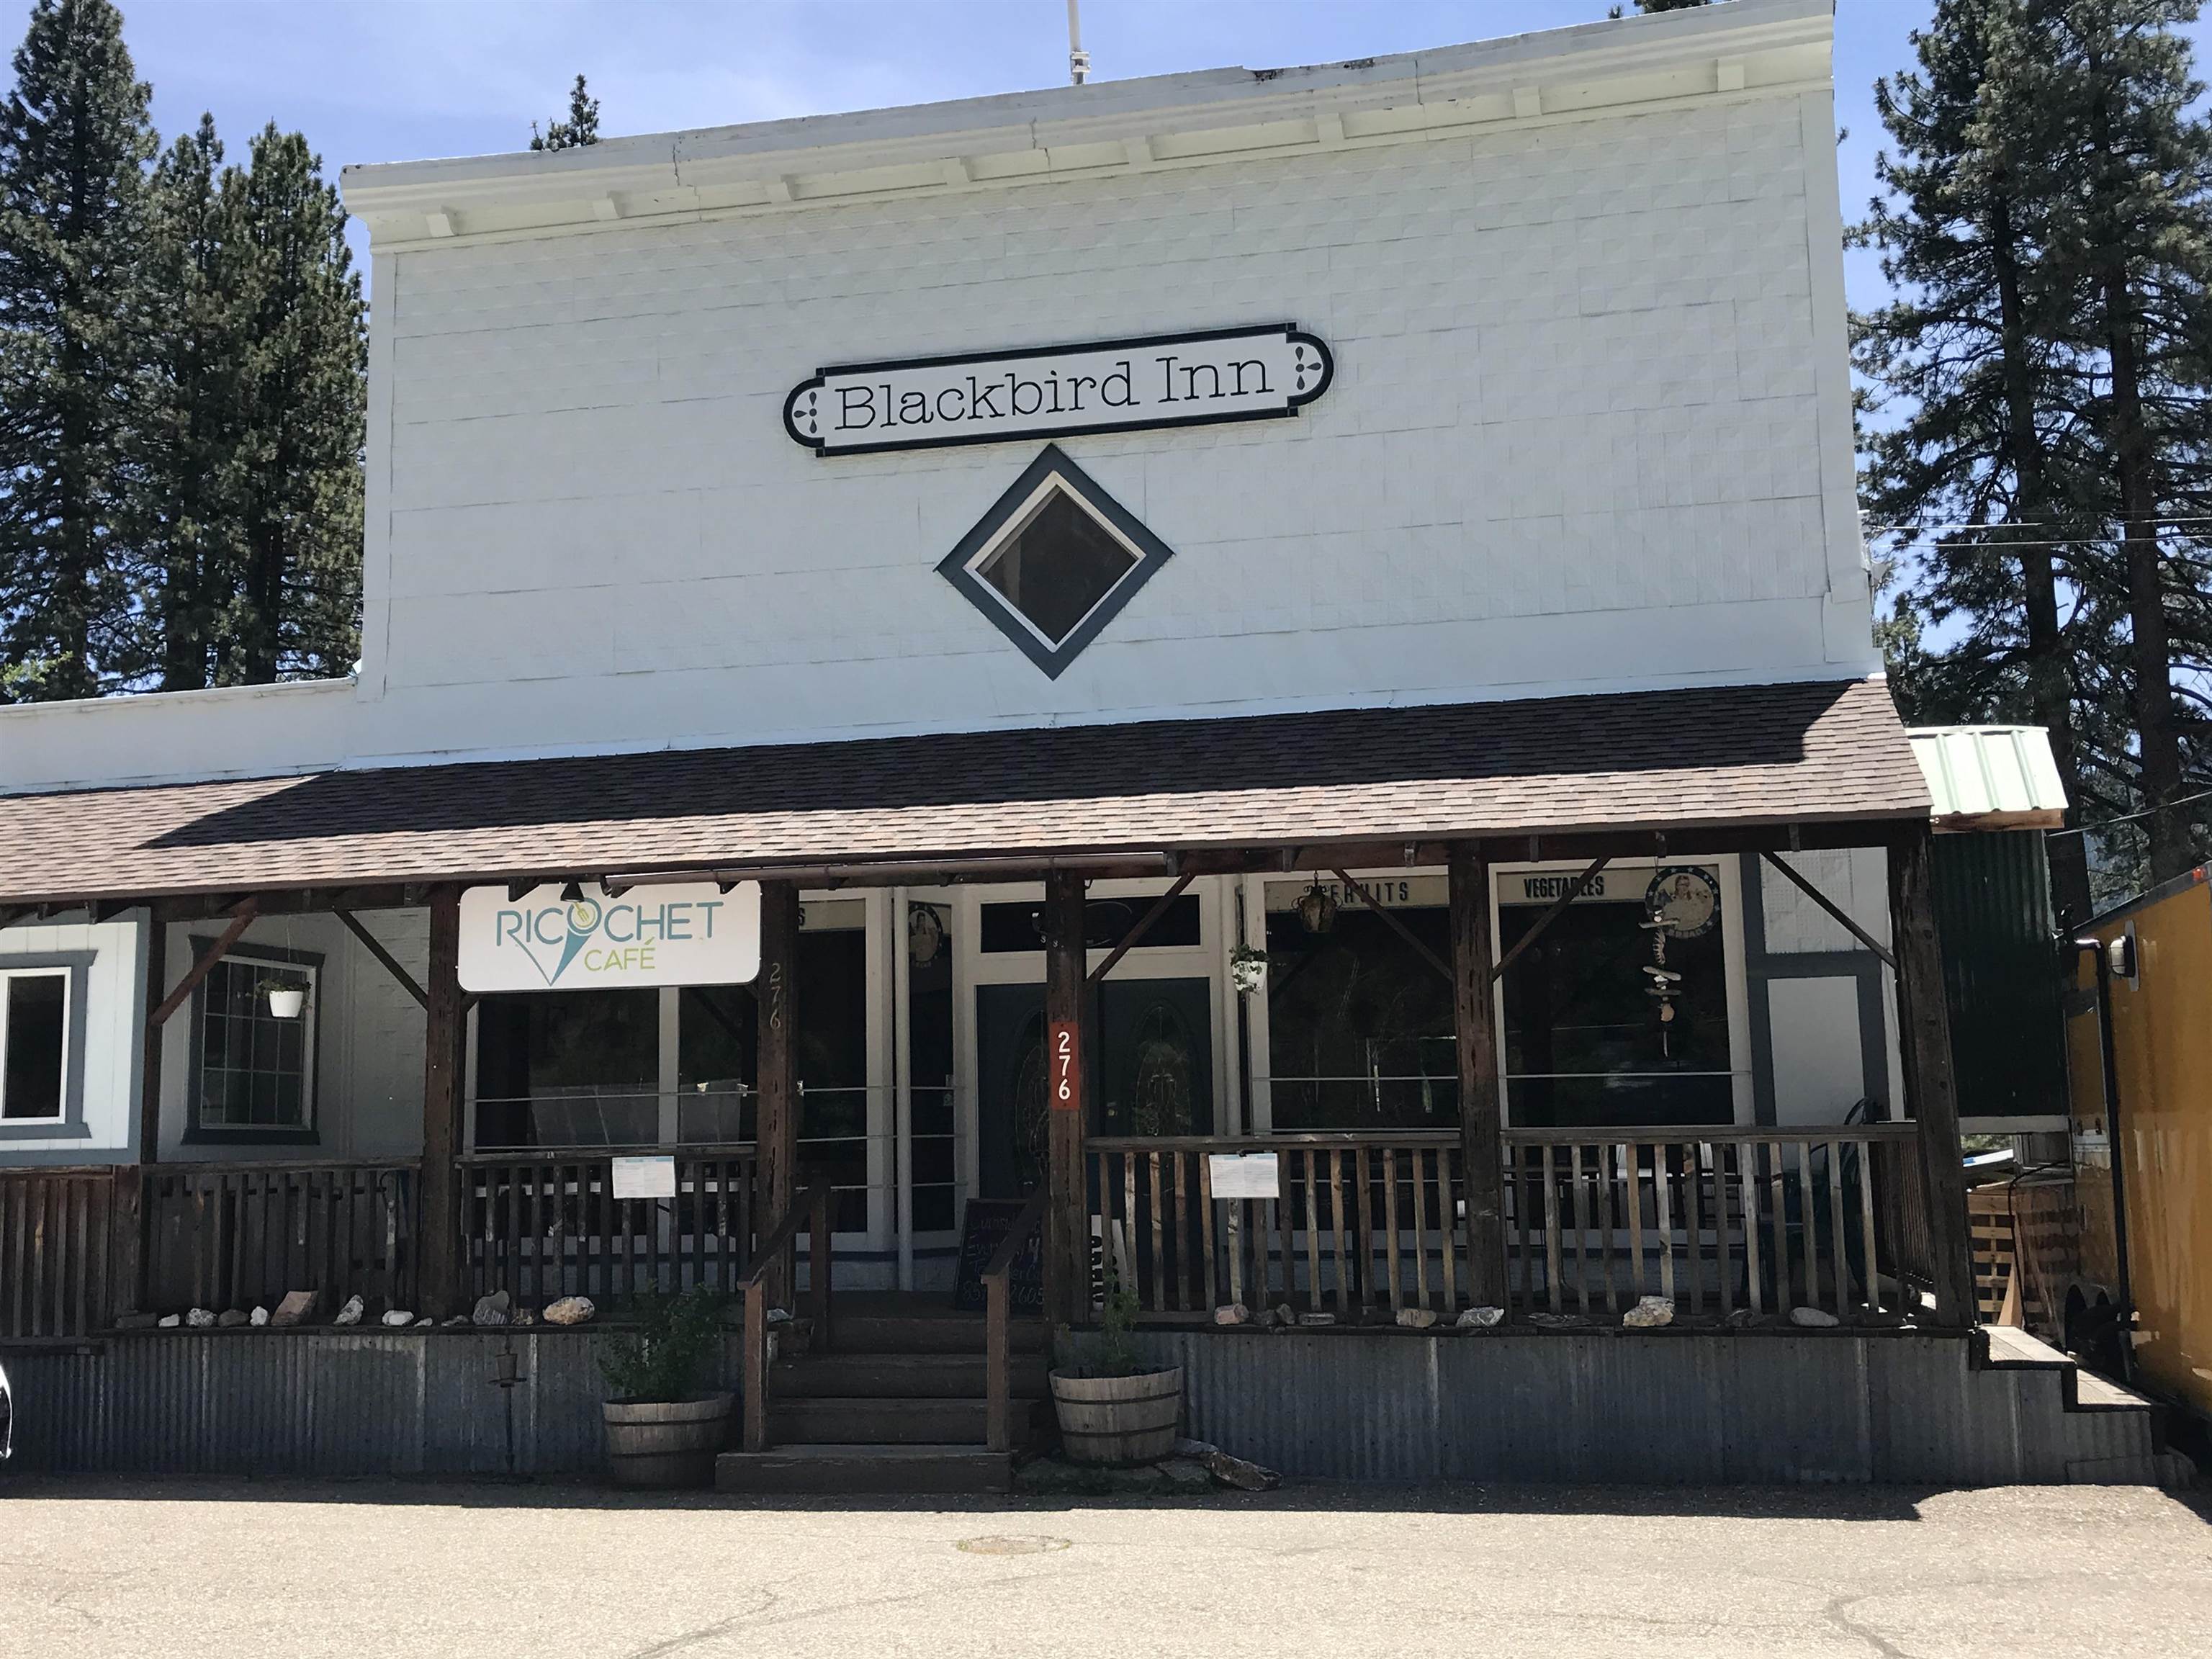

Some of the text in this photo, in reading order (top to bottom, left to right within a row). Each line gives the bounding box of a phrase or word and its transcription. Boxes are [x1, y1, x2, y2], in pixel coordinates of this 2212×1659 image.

[834, 356, 1274, 431] Blackbird Inn
[497, 897, 724, 948] RICOCHET
[584, 936, 656, 971] CAFÉ
[769, 962, 781, 1030] 276
[1058, 1031, 1071, 1100] 276
